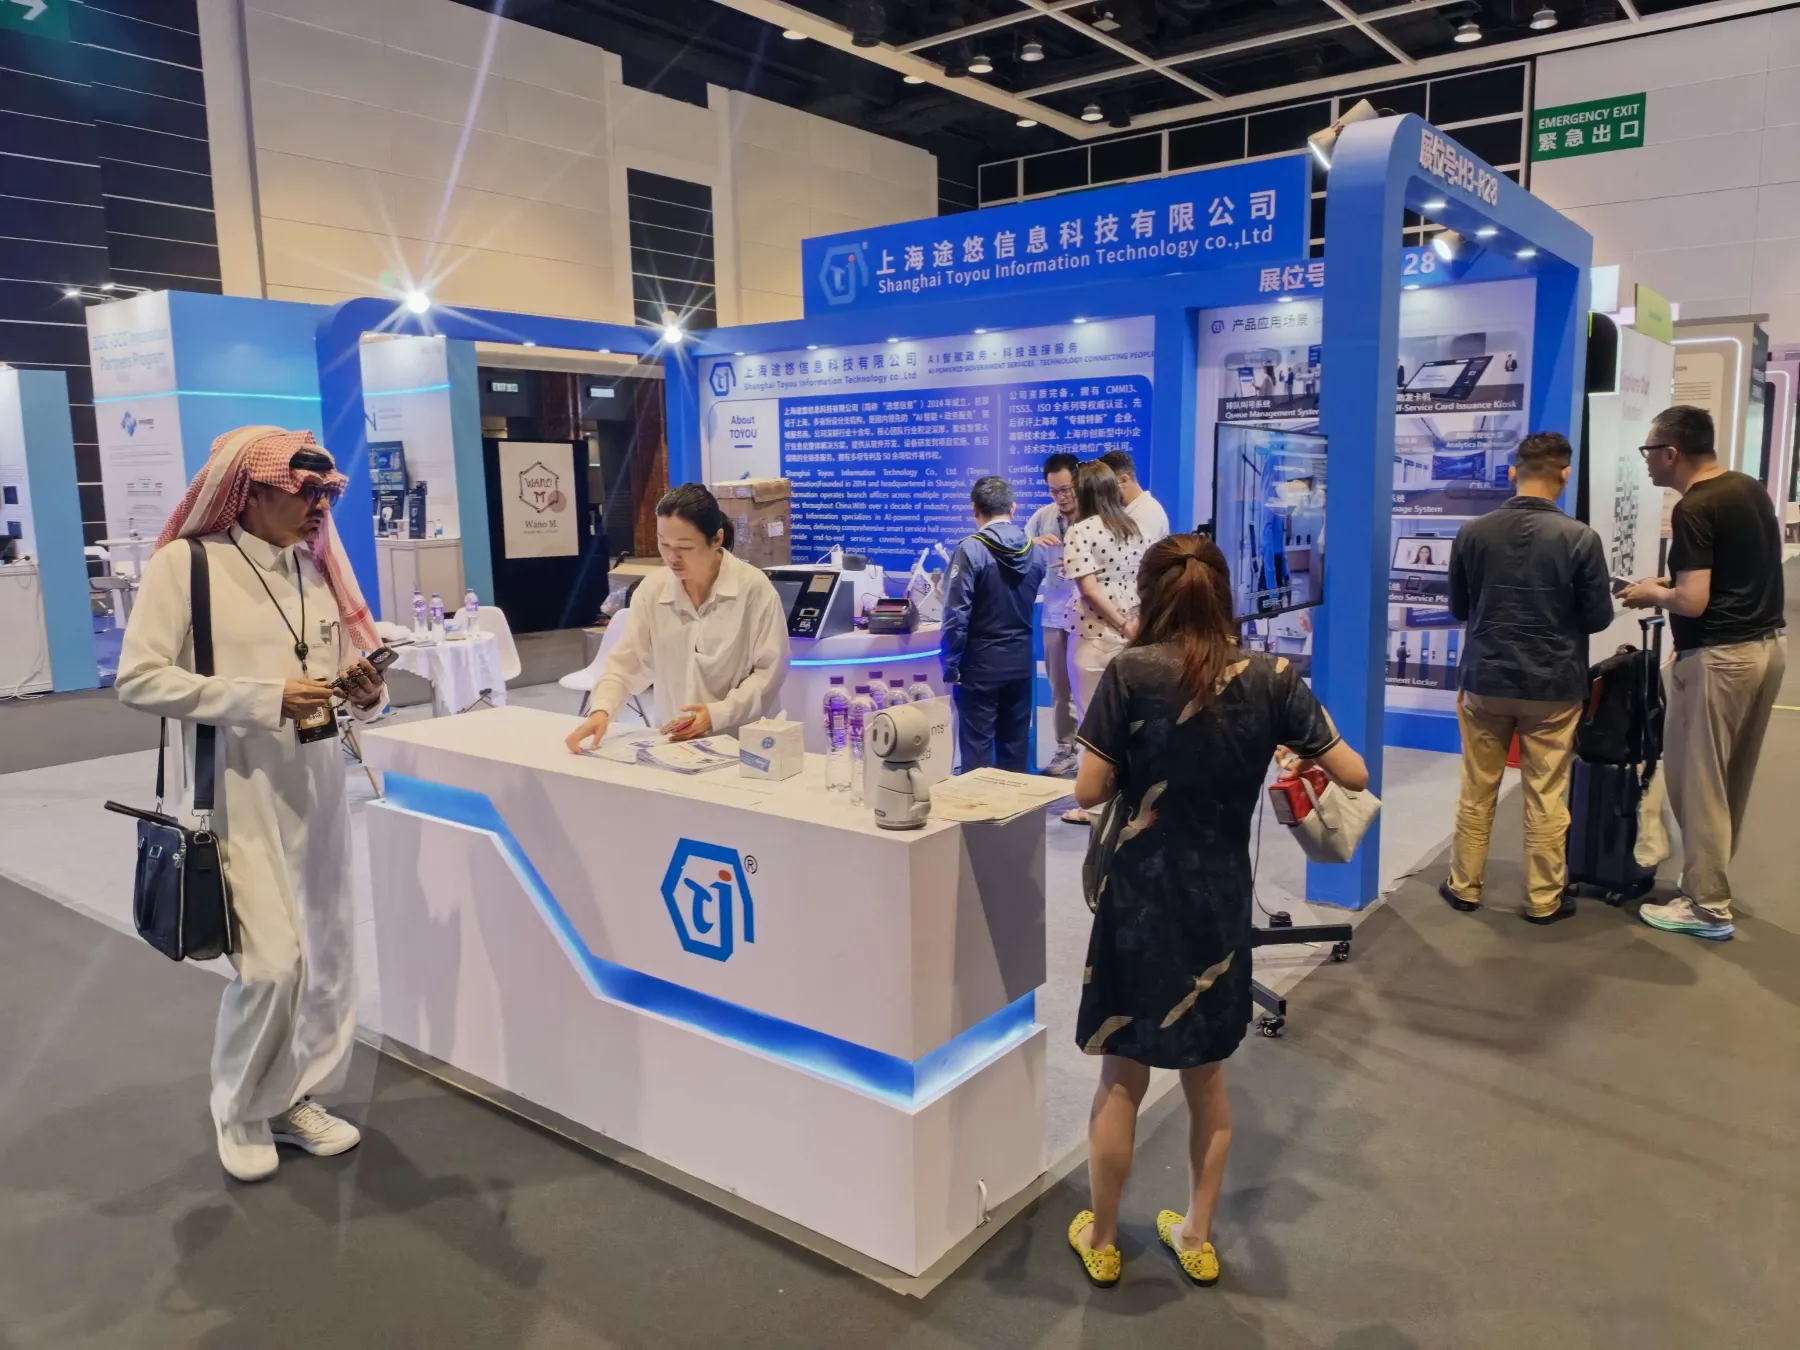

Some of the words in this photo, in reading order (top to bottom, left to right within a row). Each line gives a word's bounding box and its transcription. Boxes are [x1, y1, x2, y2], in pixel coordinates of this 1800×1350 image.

[1538, 108, 1610, 130] EMERGENCY
[1612, 103, 1641, 118] EXIT
[1538, 119, 1640, 152] 緊急出口
[876, 189, 1277, 276] 上海途悠信息科技有限公司
[878, 270, 942, 295] Shanghai
[945, 266, 990, 288] Toyou
[995, 254, 1090, 278] Information
[1096, 237, 1199, 265] Technology
[744, 352, 917, 378] 上海途悠信息科技有限公司
[964, 362, 1005, 372] GOVERNMENT
[1040, 356, 1082, 366] TECHNOLOGY
[1084, 352, 1128, 363] CONNECTING
[744, 382, 775, 391] Shanghai
[777, 380, 797, 390] Toyou
[799, 377, 843, 387] Information
[845, 374, 887, 384] Technology
[1434, 402, 1455, 411] Card
[1456, 401, 1492, 410] Issuance
[1493, 400, 1517, 409] Kiosk
[1225, 411, 1249, 420] Queue
[1249, 409, 1296, 419] Management
[731, 415, 756, 425] About
[729, 429, 757, 439] TOYOU
[785, 469, 811, 479] Shanghai
[817, 469, 834, 479] Toyou
[841, 469, 876, 477] Information
[883, 468, 918, 478] Technology
[1008, 465, 1039, 473] Certified
[852, 480, 866, 488] 2014
[867, 480, 880, 488] and
[880, 480, 926, 489] headquartered
[820, 491, 844, 500] operates
[846, 491, 867, 499] branch
[869, 491, 889, 499] offices
[913, 490, 940, 500] multiple
[801, 502, 834, 511] throughout
[890, 502, 912, 510] decade
[923, 502, 950, 512] industry
[1414, 505, 1443, 514] System
[841, 513, 872, 522] specializes
[884, 513, 920, 523] AI-powered
[923, 514, 962, 523] government
[525, 520, 547, 528] Wano
[813, 523, 841, 533] delivering
[842, 524, 885, 533] comprehensive
[886, 525, 904, 533] smart
[904, 525, 927, 533] service
[927, 525, 939, 533] hall
[790, 533, 808, 541] rovide
[813, 534, 844, 542] end-to-end
[850, 535, 873, 543] services
[879, 535, 905, 545] covering
[845, 546, 866, 556] project
[1405, 594, 1434, 603] Service
[1412, 677, 1438, 686] Locker
